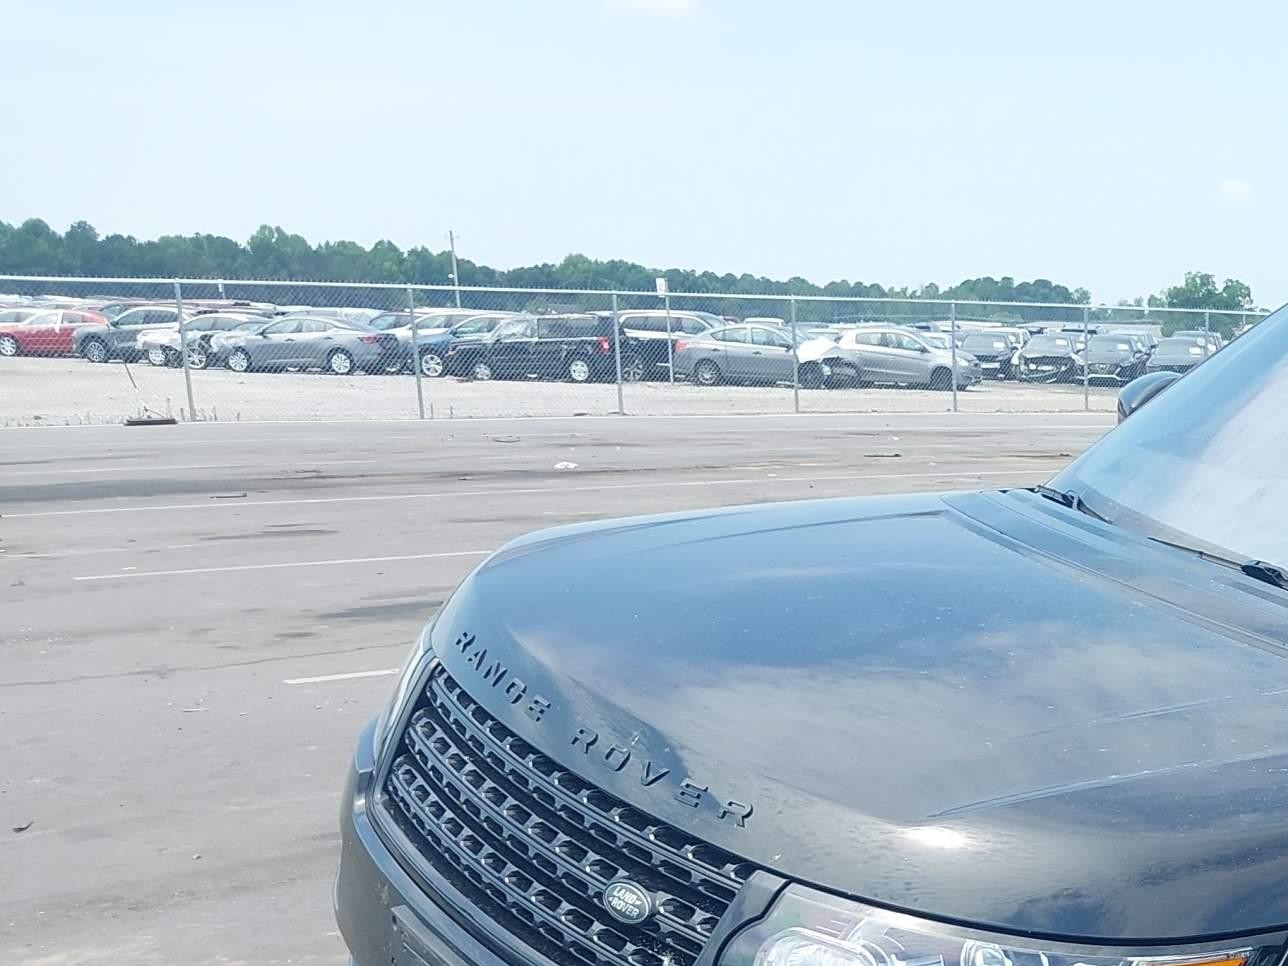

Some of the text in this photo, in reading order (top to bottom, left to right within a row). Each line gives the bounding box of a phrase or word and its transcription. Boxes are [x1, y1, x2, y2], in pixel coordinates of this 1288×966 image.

[455, 630, 755, 829] RANGE ROVER
[612, 886, 638, 905] LAND
[610, 896, 640, 919] ROVER
